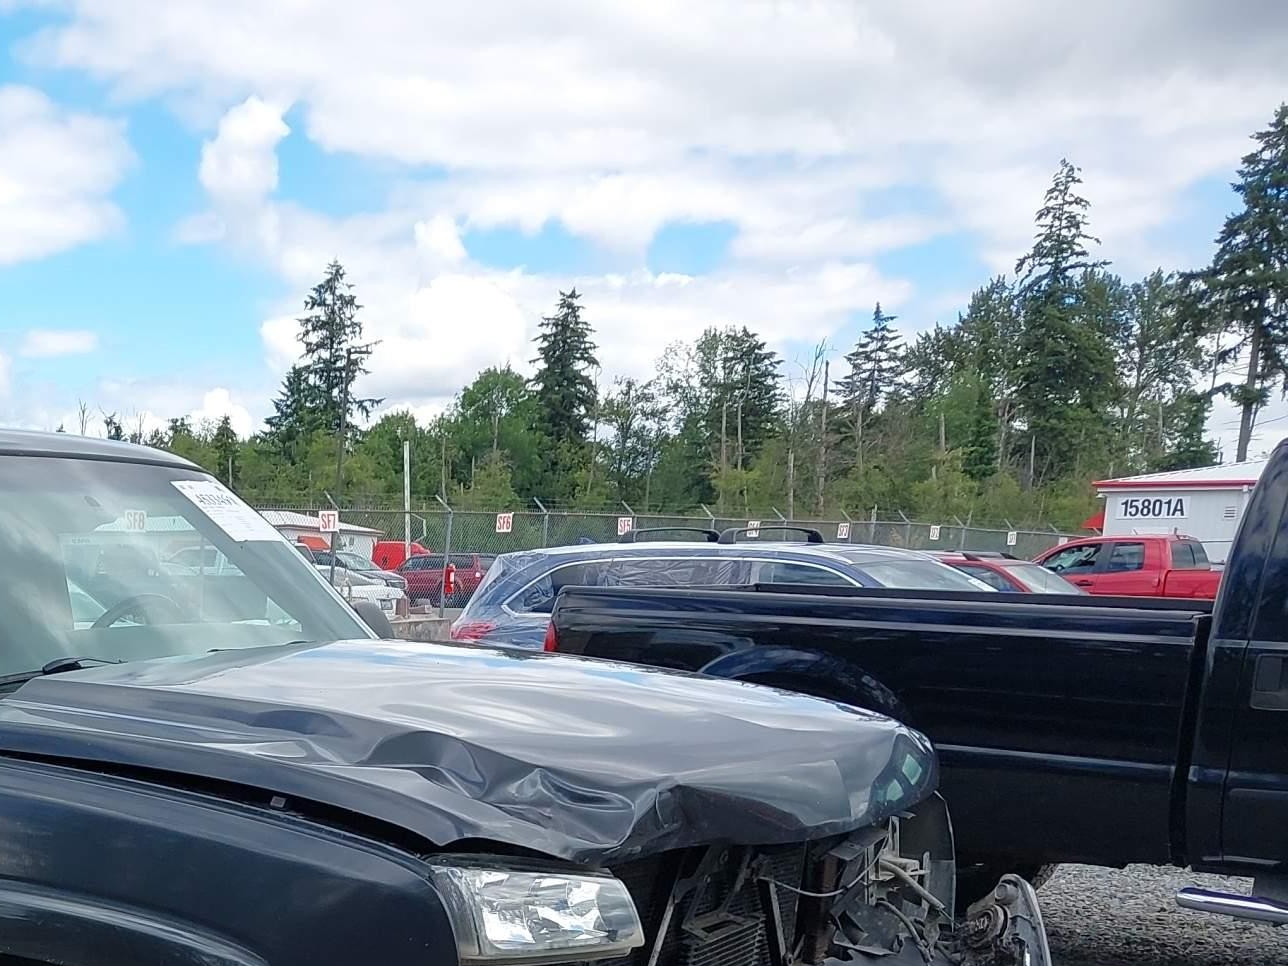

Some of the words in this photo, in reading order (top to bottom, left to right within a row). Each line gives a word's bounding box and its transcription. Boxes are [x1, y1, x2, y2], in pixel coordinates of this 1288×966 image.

[1121, 498, 1185, 517] 15801A
[126, 511, 146, 530] SF8
[320, 513, 337, 530] SF7
[497, 515, 511, 531] SF6
